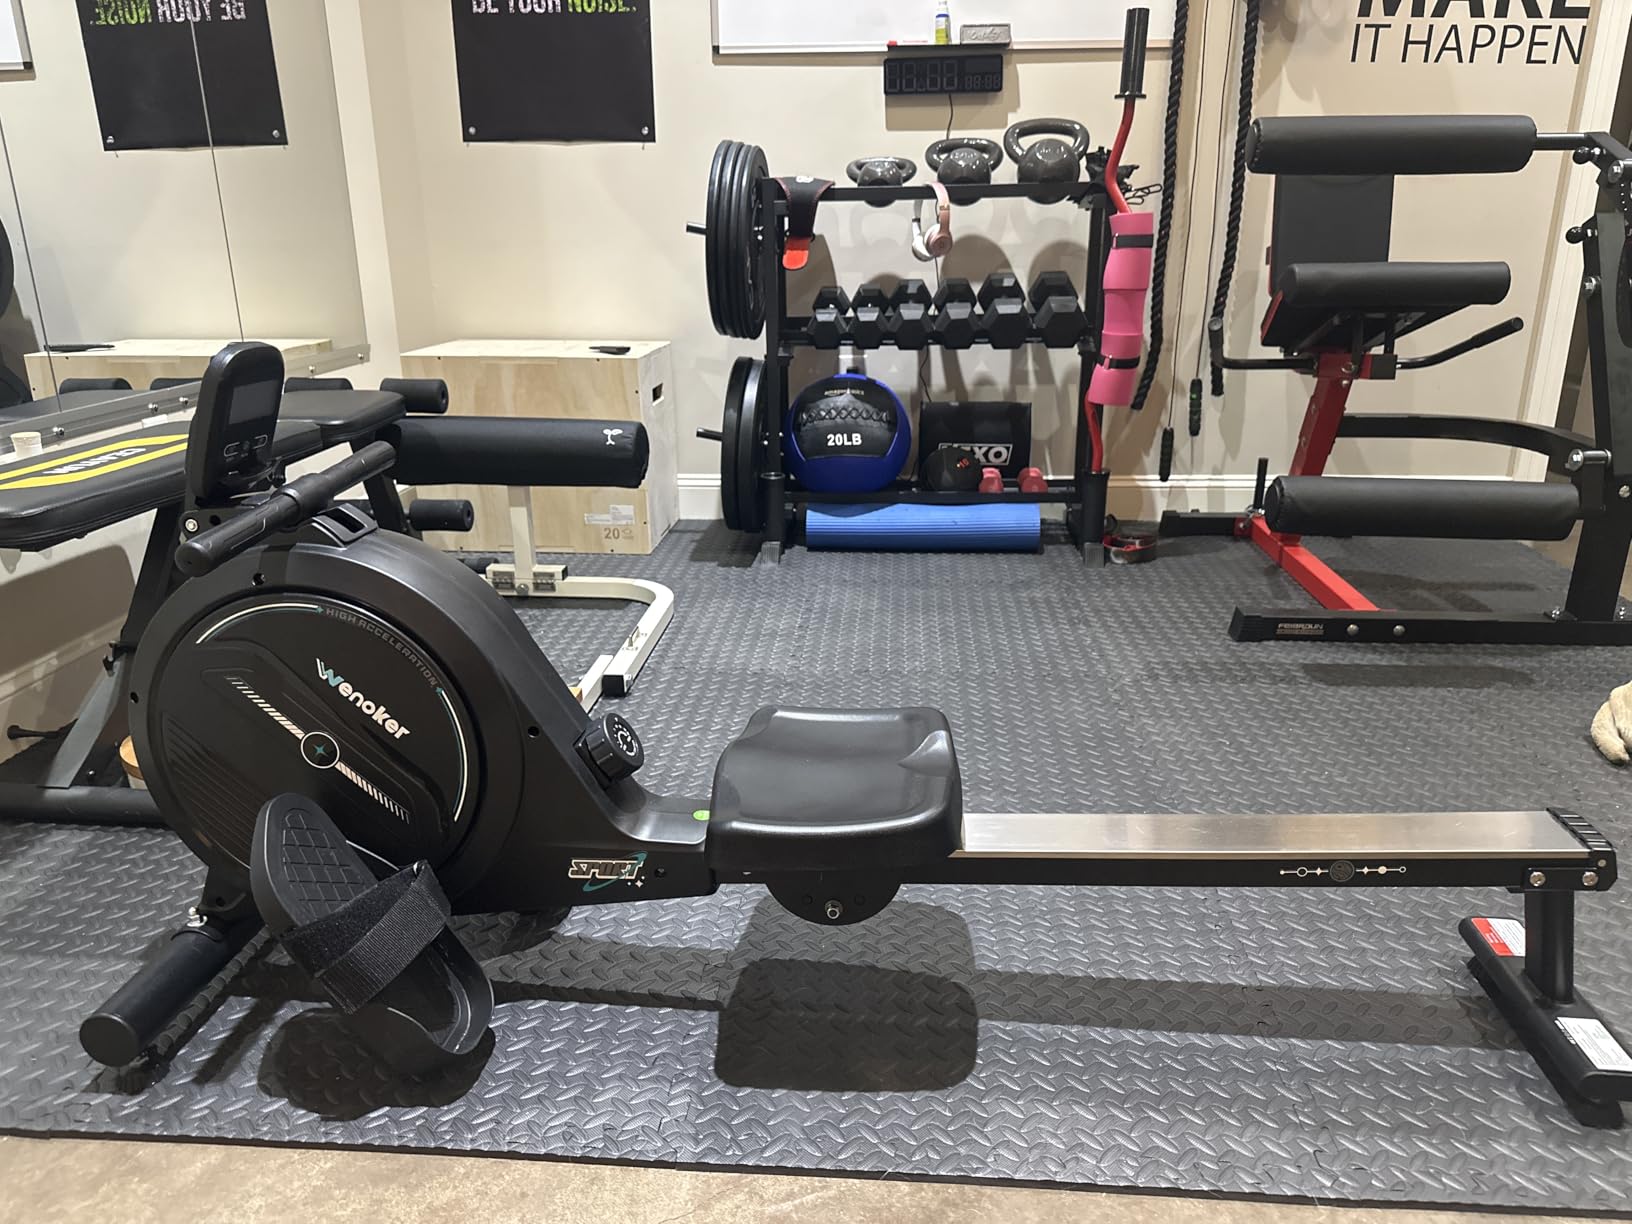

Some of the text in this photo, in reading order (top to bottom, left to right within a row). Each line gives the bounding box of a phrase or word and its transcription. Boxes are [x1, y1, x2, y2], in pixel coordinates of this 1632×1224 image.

[1350, 23, 1588, 64] IT HAPPEN
[826, 433, 863, 446] 20LB
[604, 527, 620, 540] 20
[326, 607, 438, 687] HIGH ACCELERATION
[316, 657, 411, 740] Wenoker
[568, 859, 644, 879] SPORT
